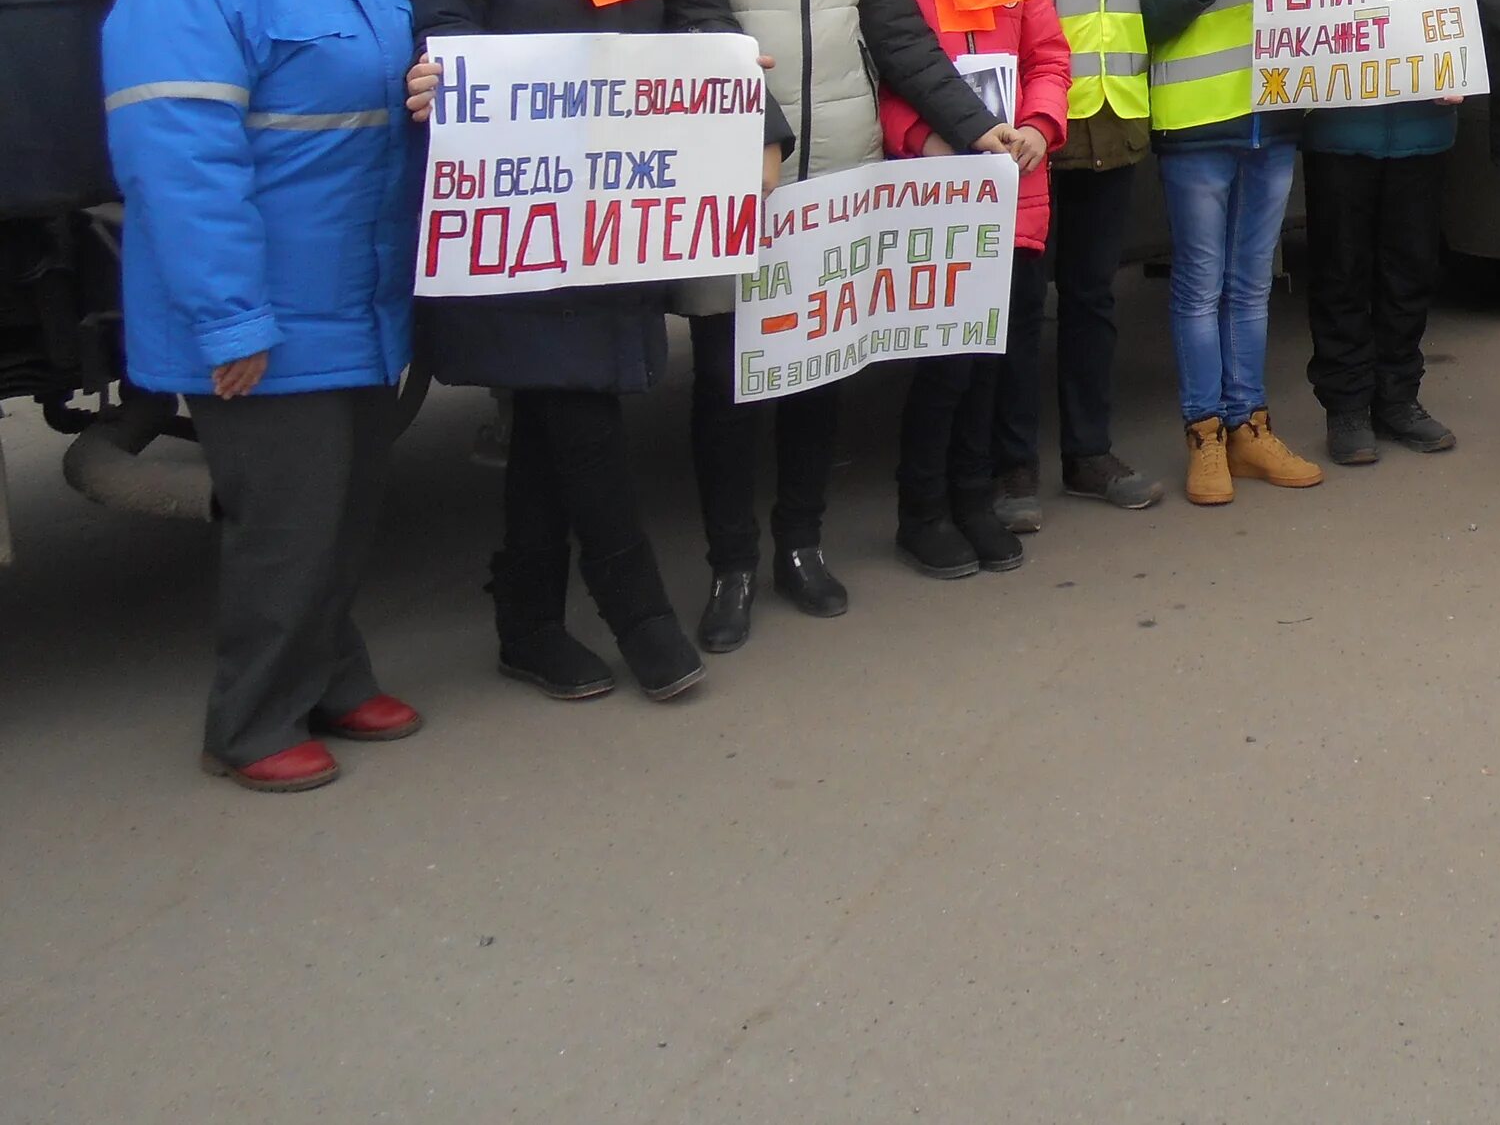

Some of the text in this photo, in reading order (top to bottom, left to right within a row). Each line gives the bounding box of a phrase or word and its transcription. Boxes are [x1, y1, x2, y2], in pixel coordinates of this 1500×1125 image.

[1255, 6, 1465, 60] НАКАЖЕТ БЕЗ
[1256, 46, 1468, 106] ЖАЛОСТИ!
[432, 150, 678, 200] ВЫ ВЕДЬ ТОЖЕ
[741, 224, 1000, 302] НА ДОРОГЕ
